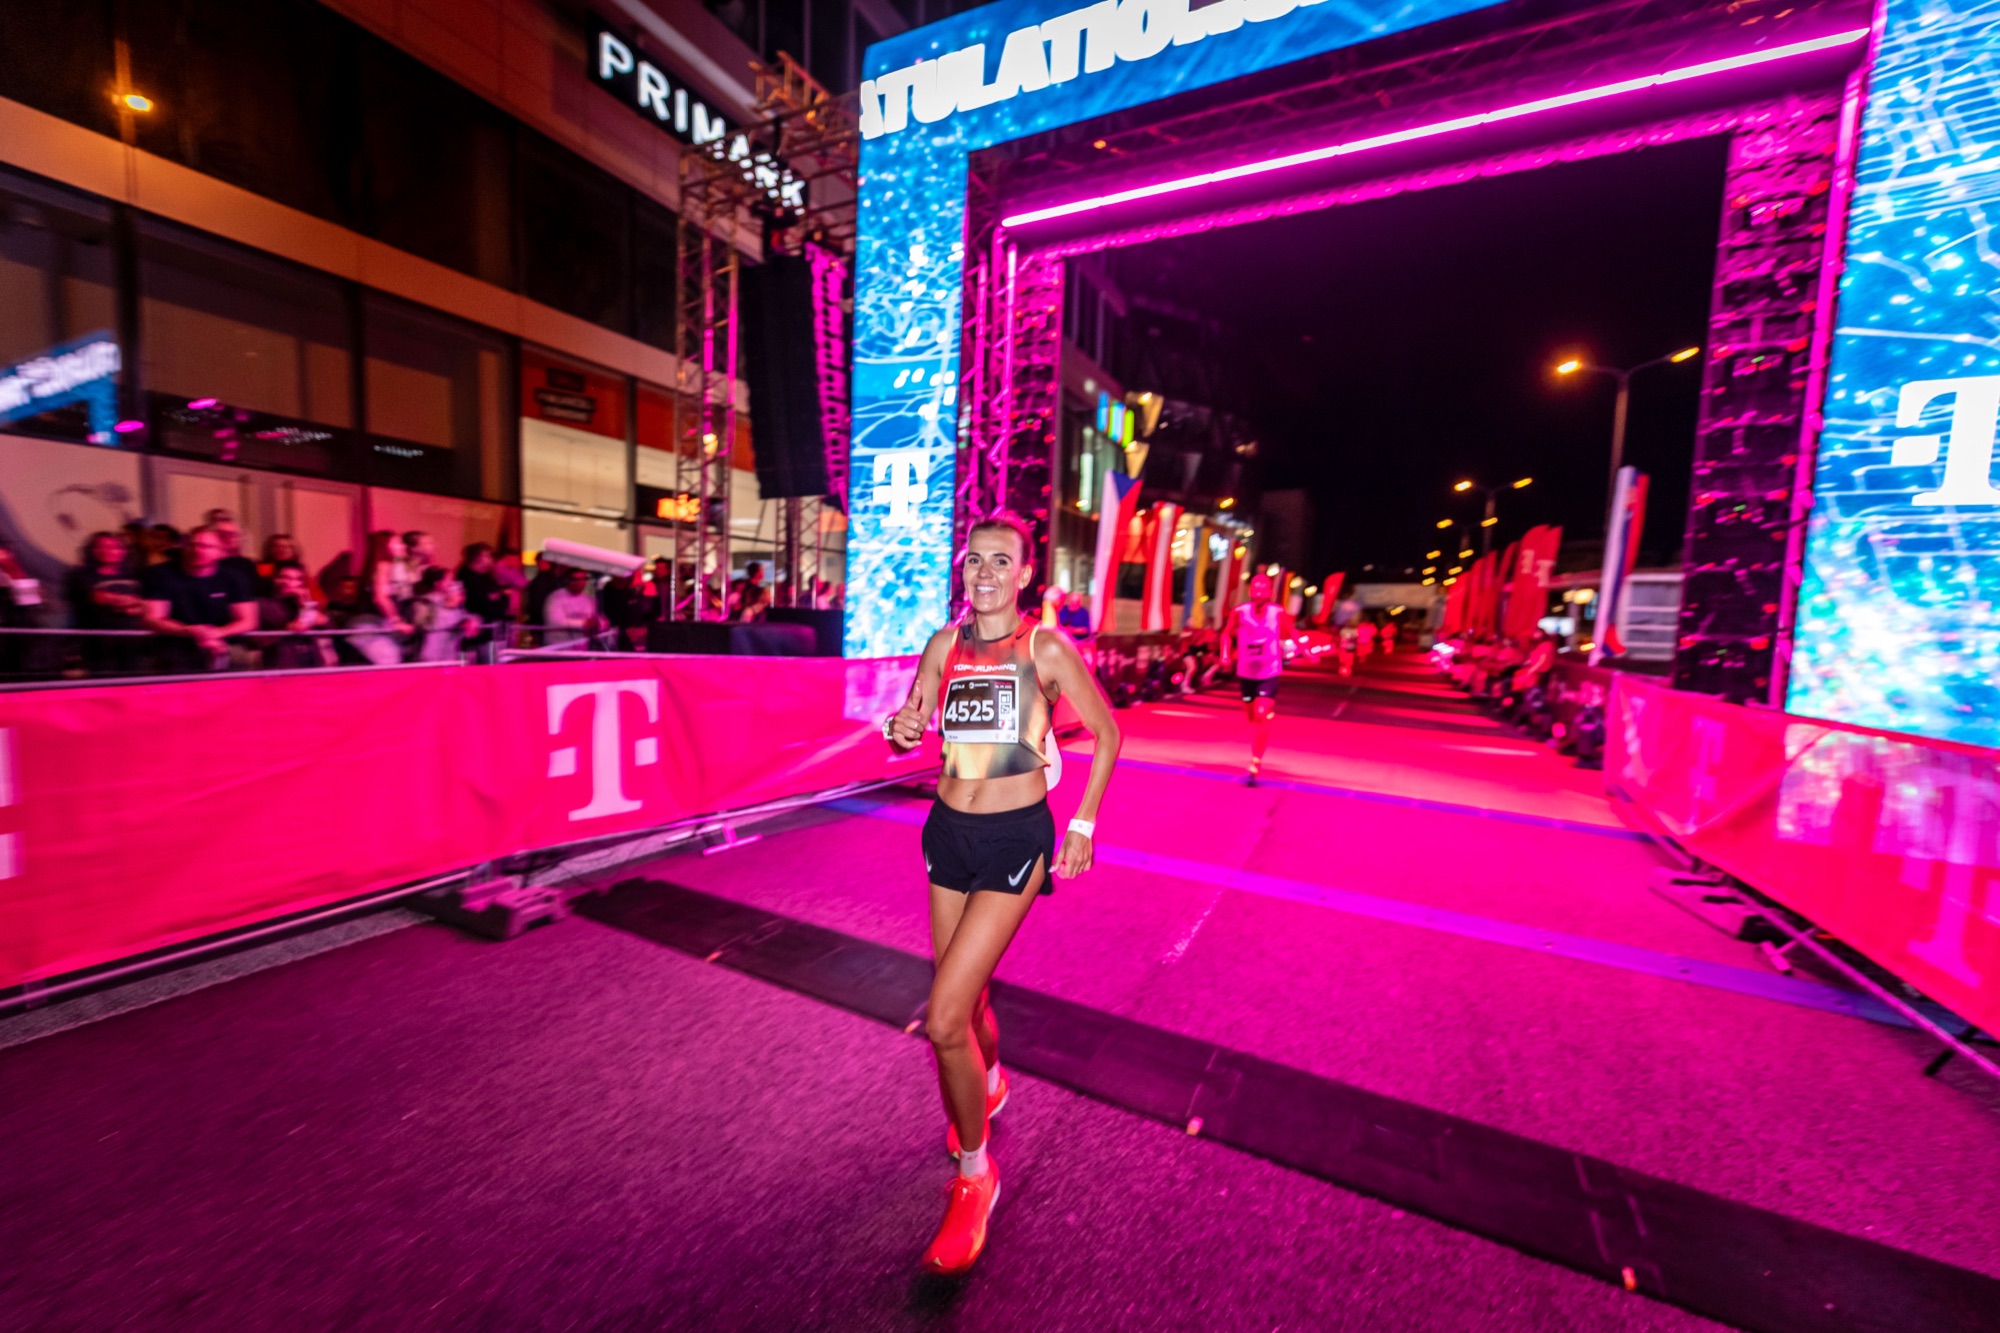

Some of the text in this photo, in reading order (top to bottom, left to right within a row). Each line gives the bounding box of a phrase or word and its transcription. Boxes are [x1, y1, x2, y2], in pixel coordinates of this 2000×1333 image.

[598, 31, 806, 216] PRIMARK
[873, 451, 930, 529] T
[1891, 375, 2000, 506] T
[546, 678, 659, 822] T
[945, 699, 995, 723] 4525
